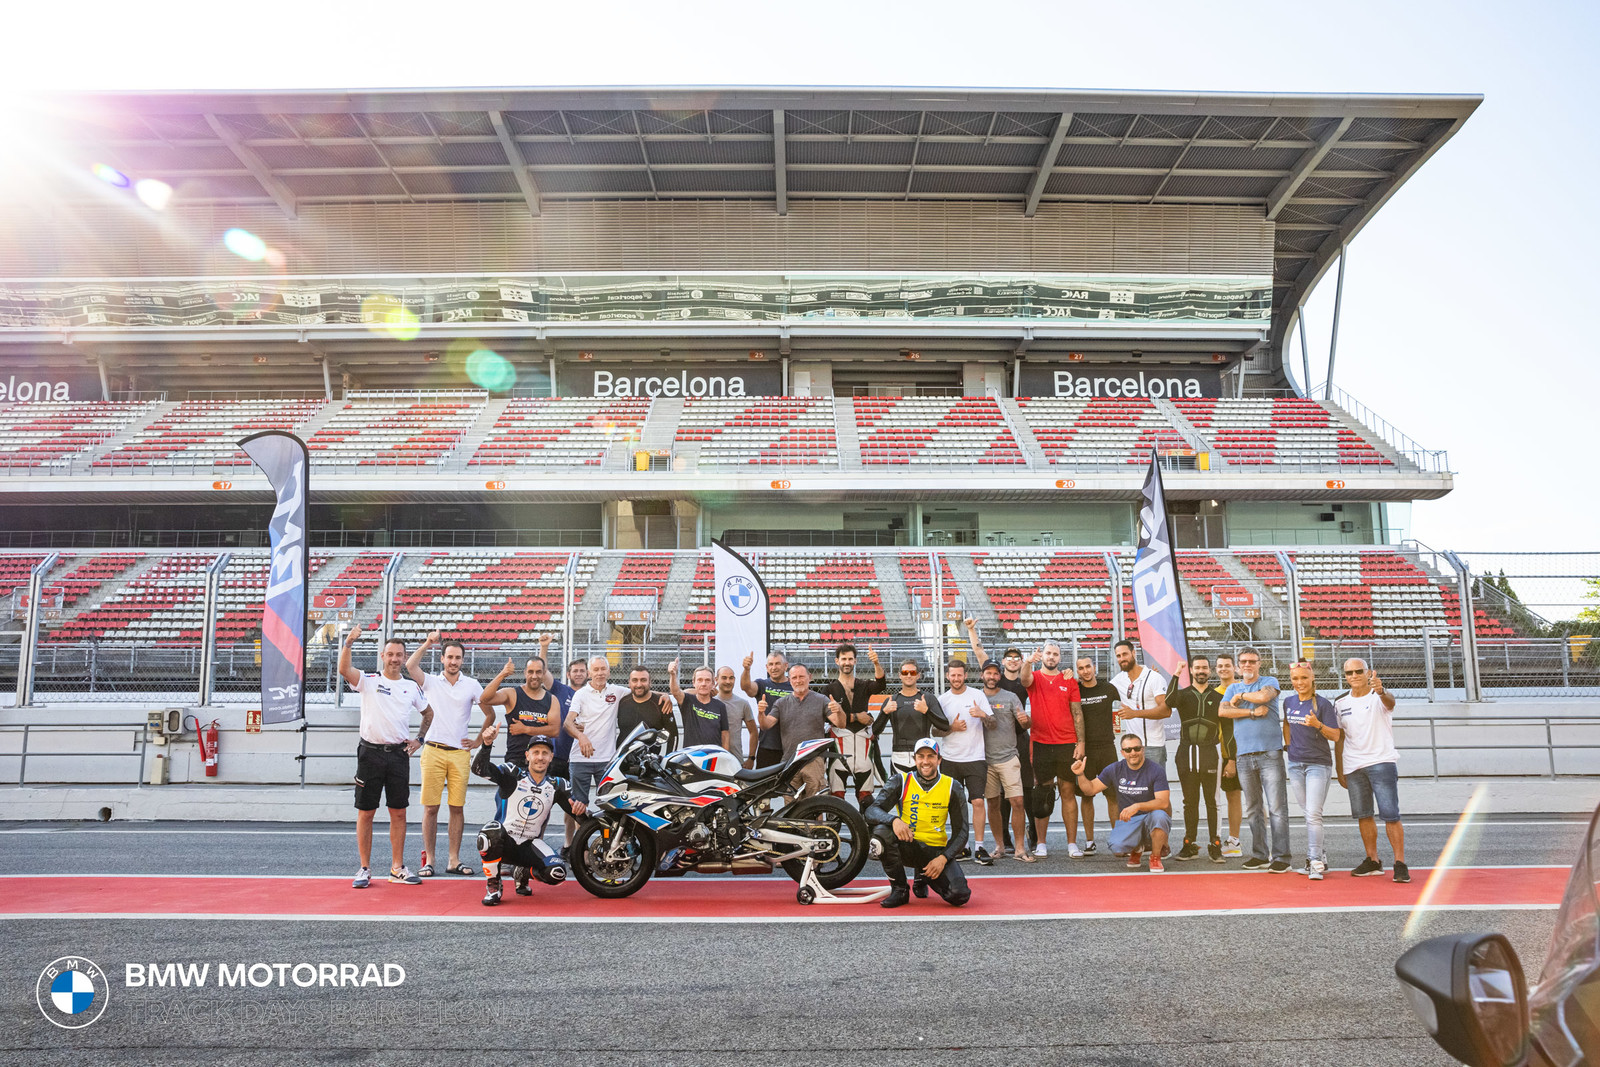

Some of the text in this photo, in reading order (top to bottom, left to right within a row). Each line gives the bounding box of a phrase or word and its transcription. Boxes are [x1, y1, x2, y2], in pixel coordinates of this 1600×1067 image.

[593, 370, 746, 397] Barcelona
[1053, 371, 1202, 398] Barcelona
[219, 481, 230, 489] 17
[494, 481, 505, 489] 18
[779, 481, 789, 489] 19
[1062, 480, 1074, 488] 20
[1333, 481, 1343, 489] 21
[909, 794, 920, 832] KDAYS
